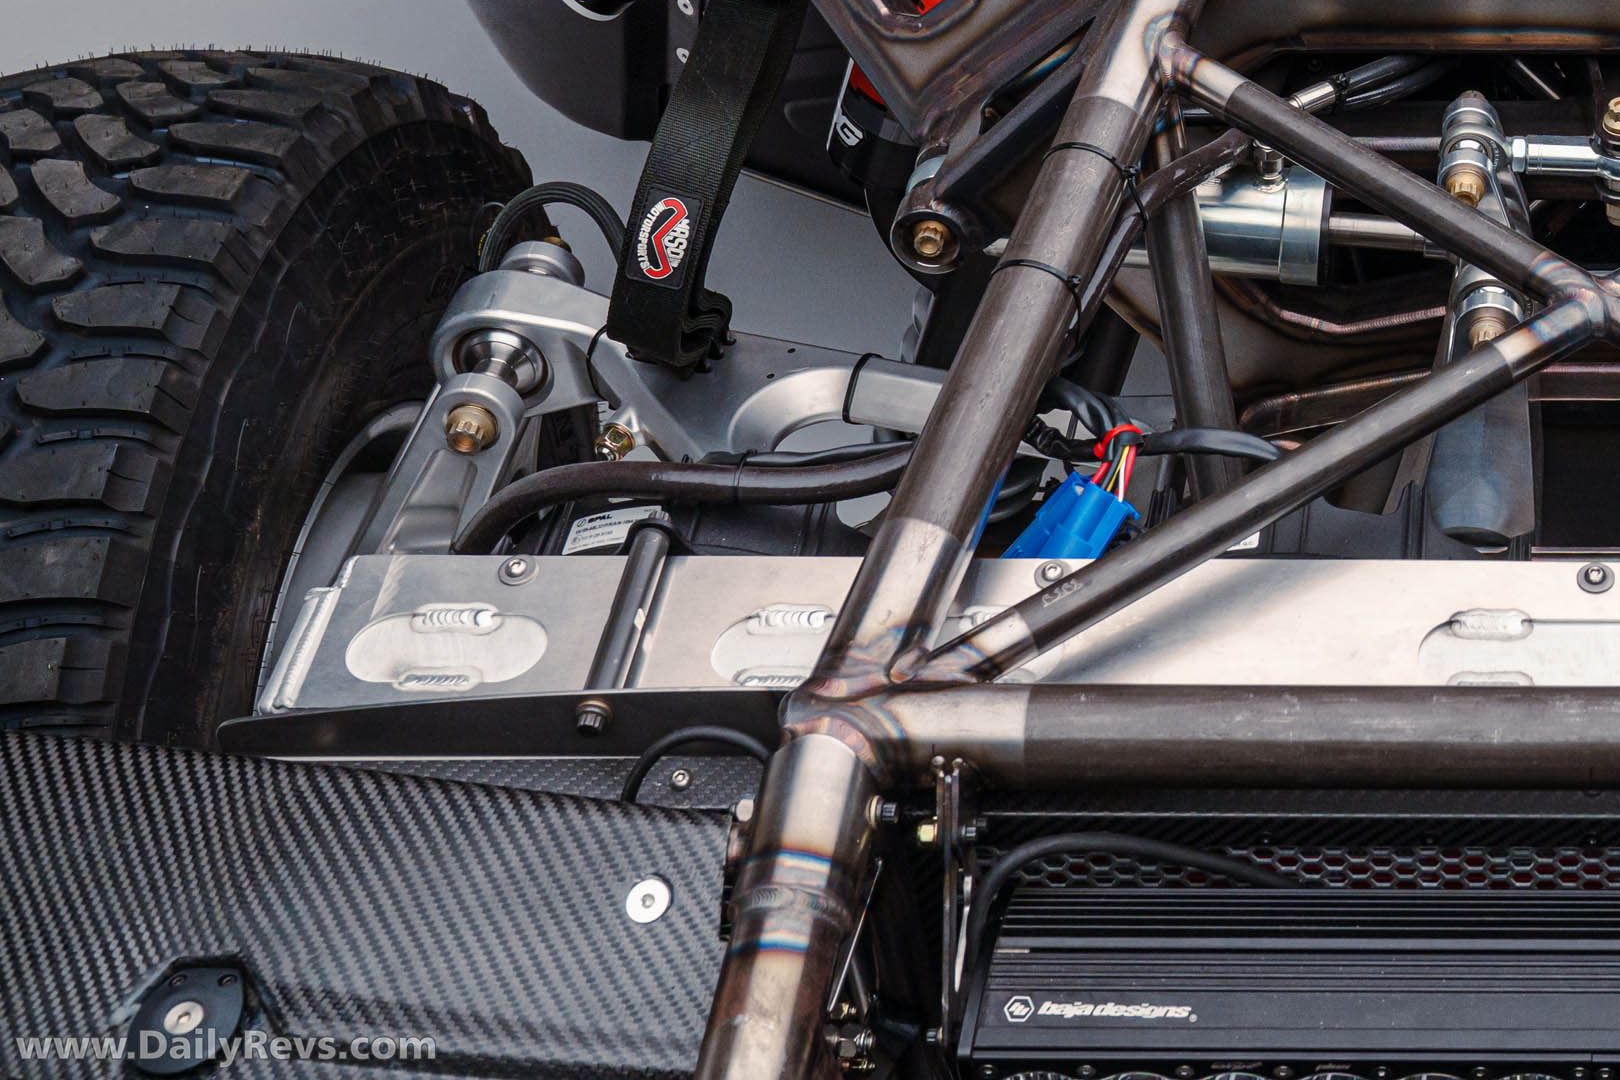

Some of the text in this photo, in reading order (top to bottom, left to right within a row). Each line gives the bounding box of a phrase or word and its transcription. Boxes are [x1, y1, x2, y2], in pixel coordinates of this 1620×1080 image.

[637, 201, 665, 269] MOTORSPORTS
[1037, 1001, 1191, 1019] baja designs
